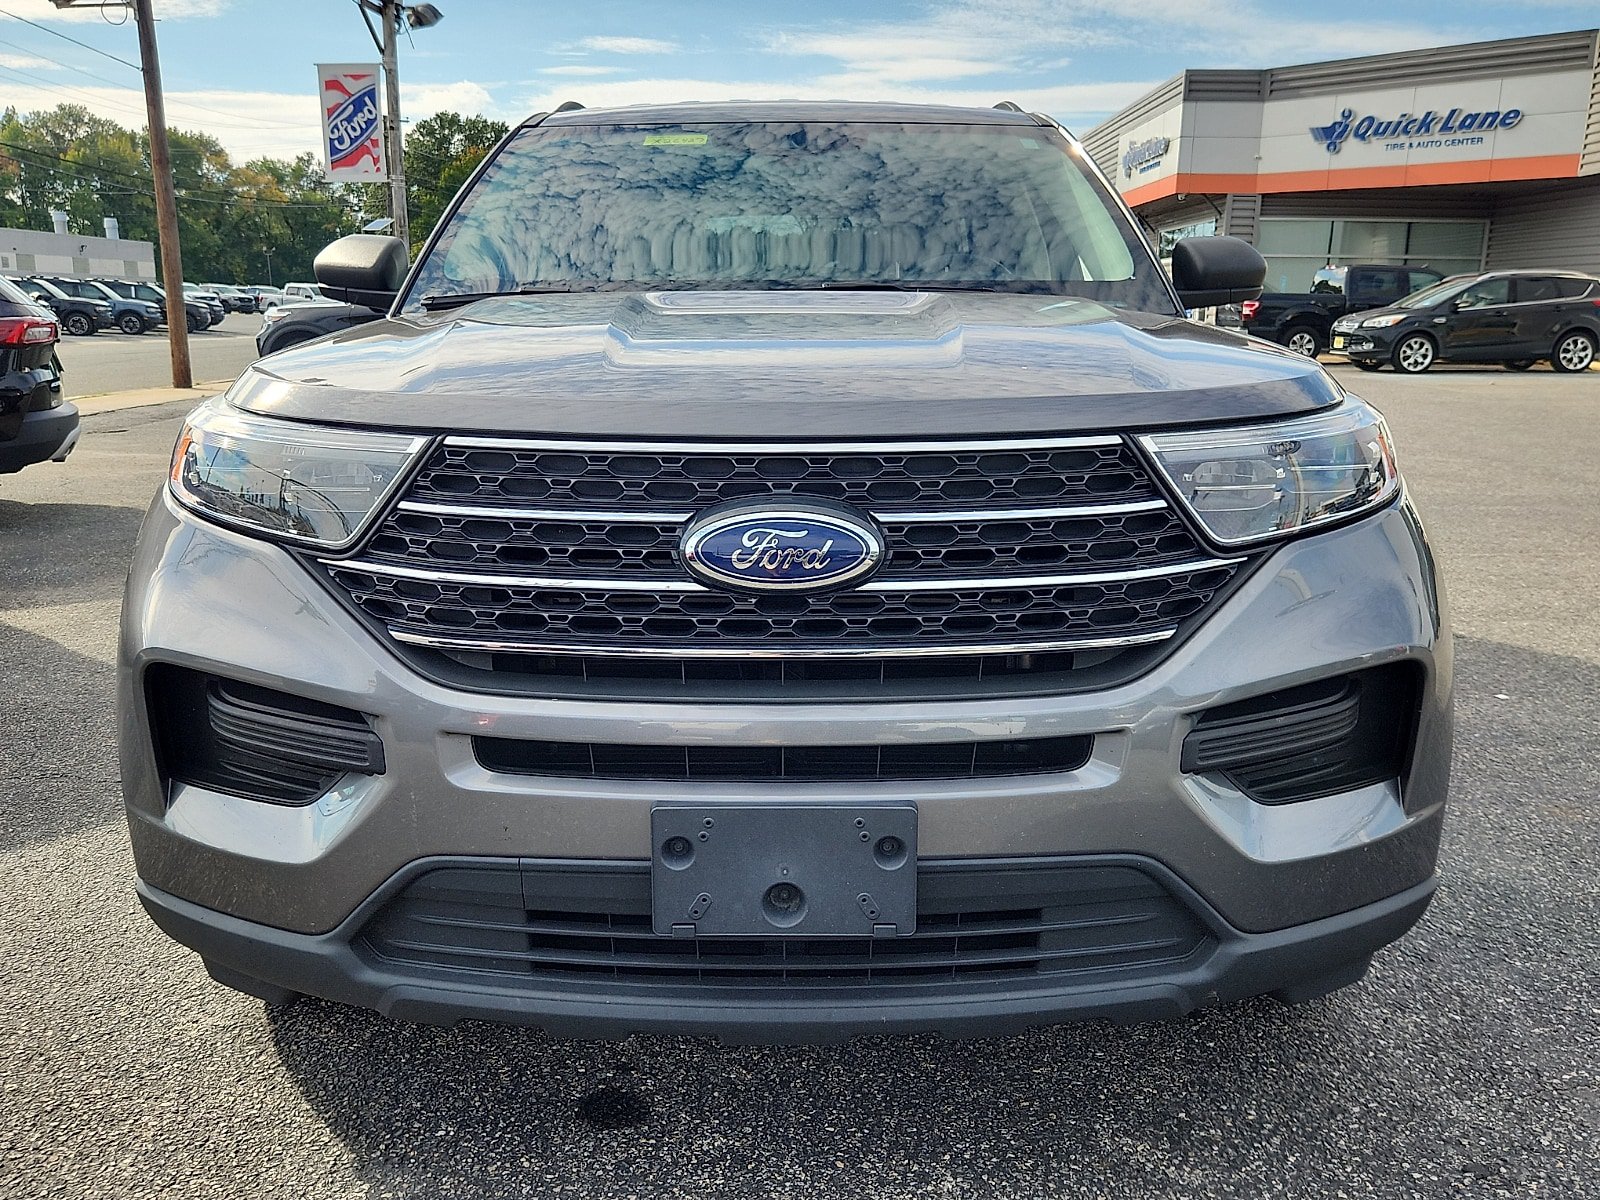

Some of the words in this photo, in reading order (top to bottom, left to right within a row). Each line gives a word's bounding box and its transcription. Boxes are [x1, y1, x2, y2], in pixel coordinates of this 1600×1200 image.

[328, 96, 377, 150] Ford
[1353, 111, 1437, 142] Quick
[1438, 107, 1523, 135] Lane
[1384, 143, 1405, 151] TIRE
[1416, 140, 1441, 149] AUTO
[1444, 137, 1484, 147] CENTER
[731, 528, 834, 570] Ford
